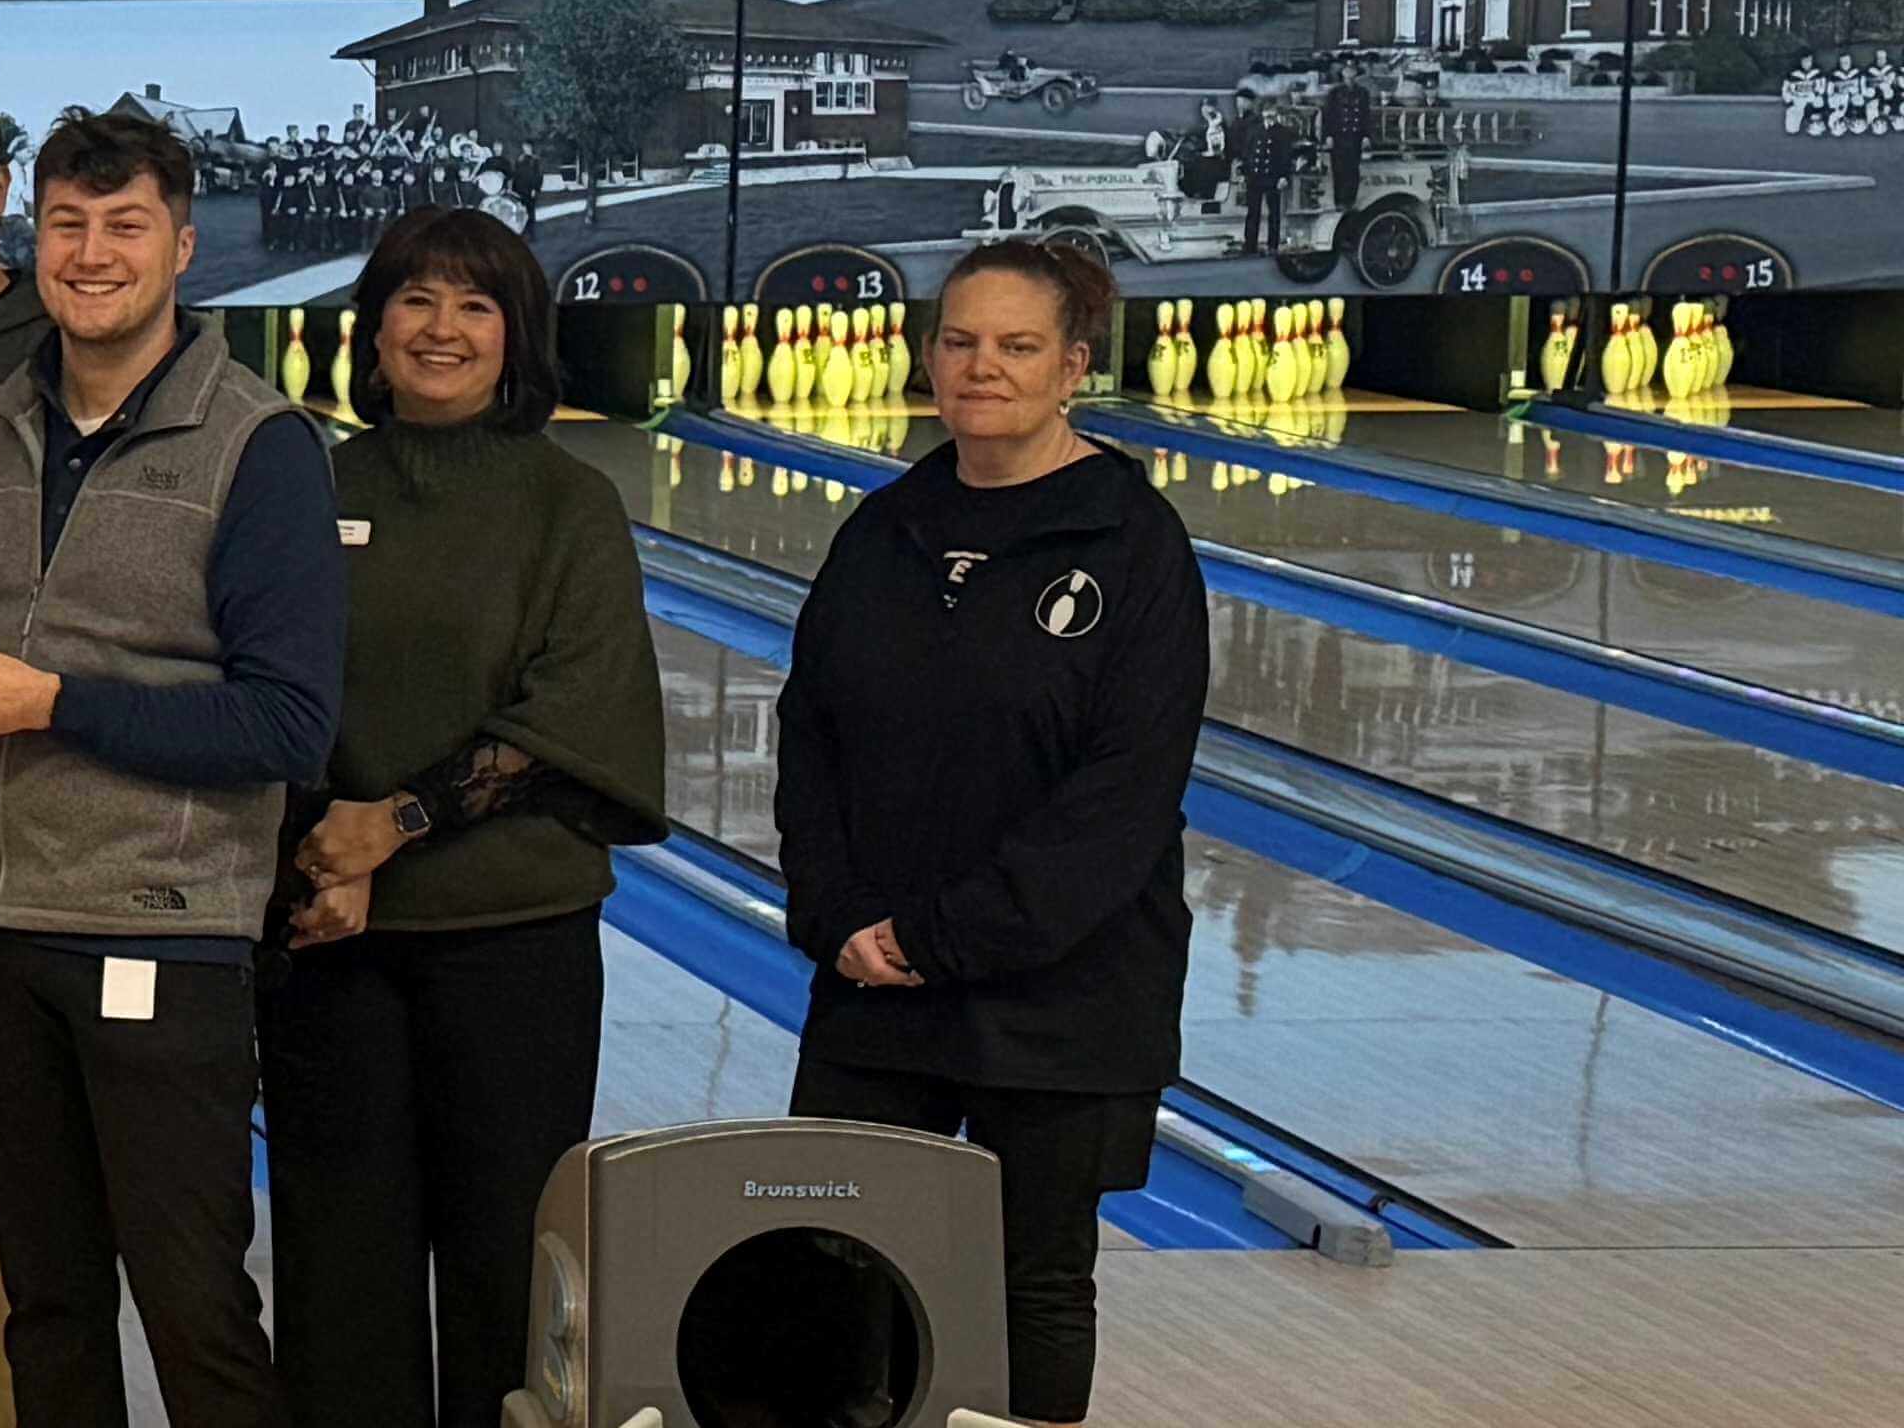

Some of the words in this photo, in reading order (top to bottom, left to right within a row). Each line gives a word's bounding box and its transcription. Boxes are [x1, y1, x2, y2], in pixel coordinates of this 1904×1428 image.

[574, 271, 602, 301] 12
[856, 269, 884, 300] 13
[1459, 262, 1486, 292] 14
[1744, 258, 1774, 287] 15
[743, 1179, 862, 1200] Brunswick
